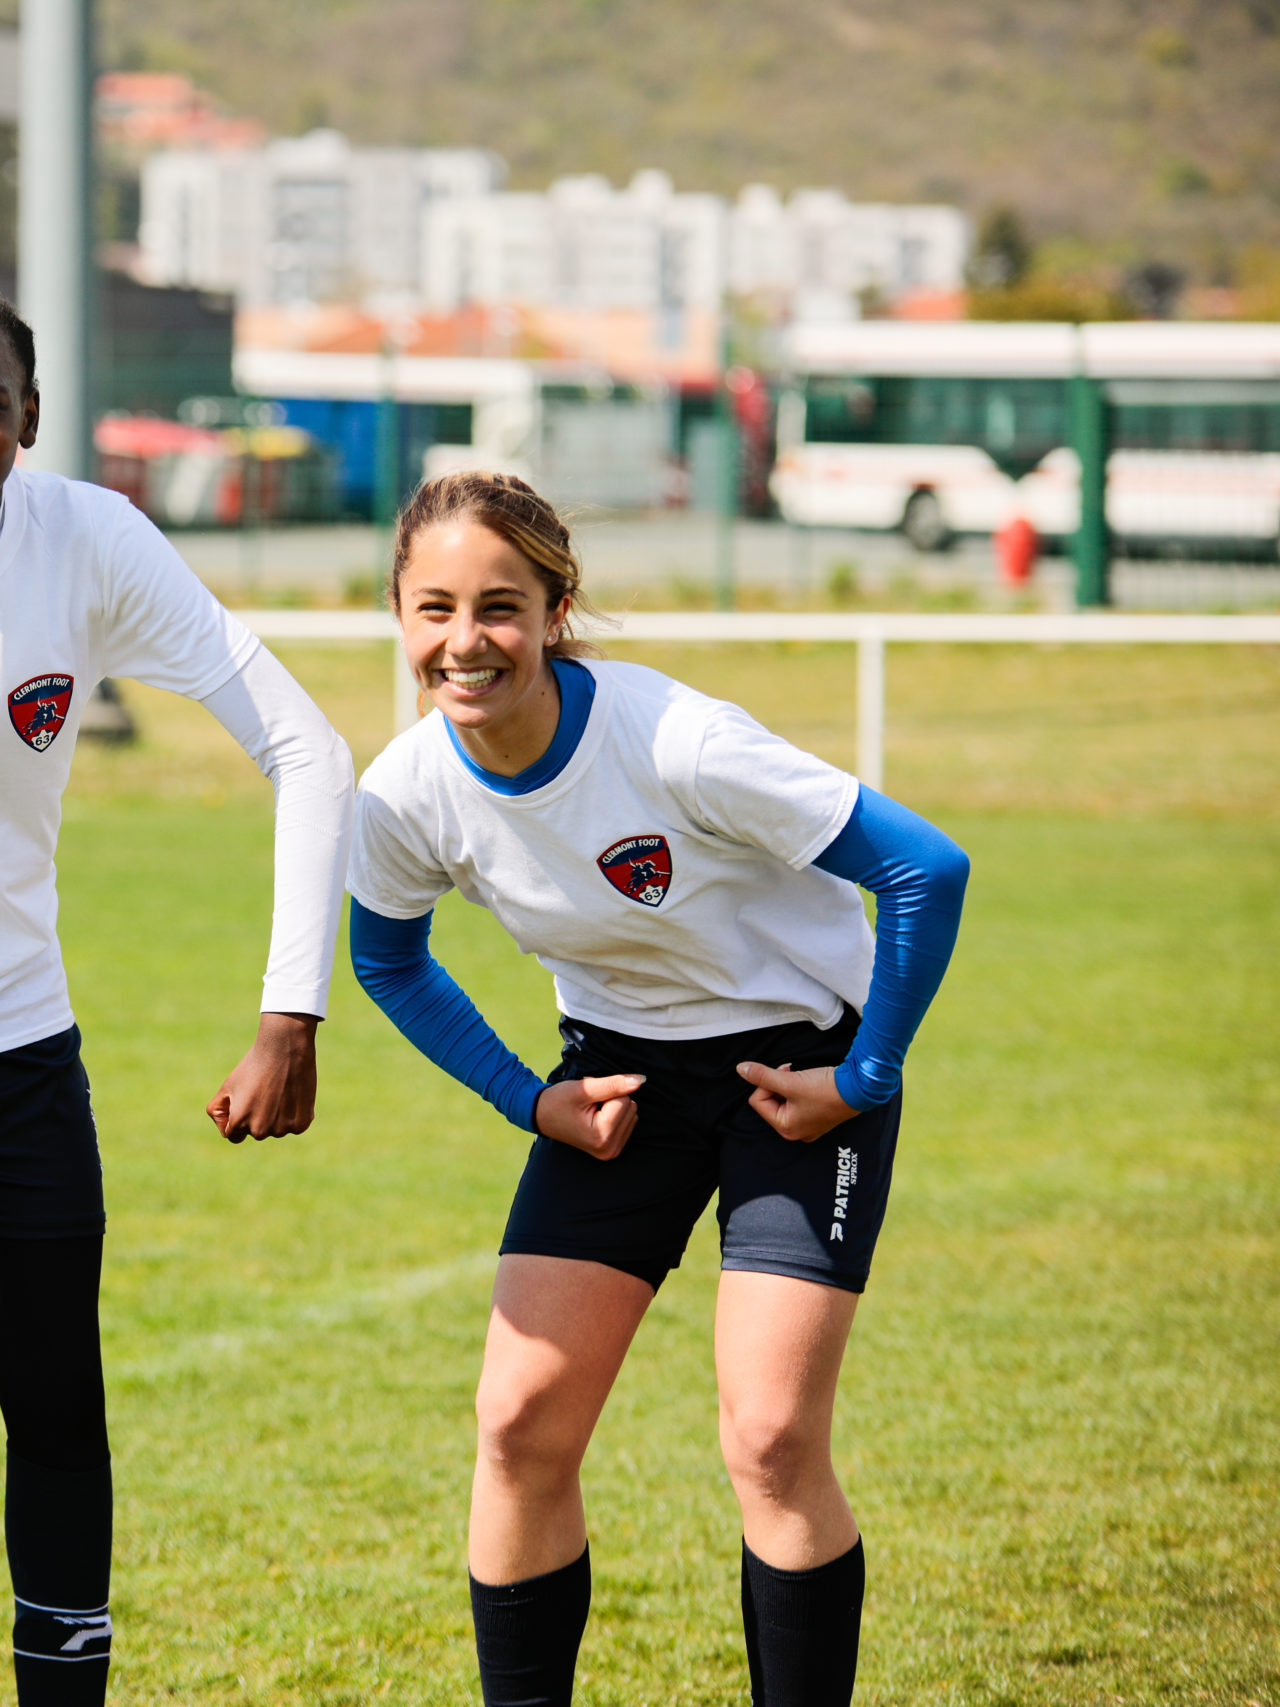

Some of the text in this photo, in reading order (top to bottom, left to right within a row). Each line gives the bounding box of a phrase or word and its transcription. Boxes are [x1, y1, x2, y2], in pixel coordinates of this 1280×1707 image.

[13, 677, 70, 700] CLERMONT FOOT
[35, 735, 50, 746] 63
[602, 838, 660, 864] CLERMONT FOOT
[644, 889, 661, 901] 63
[850, 1152, 858, 1185] SPROX
[833, 1146, 852, 1219] PATRICK
